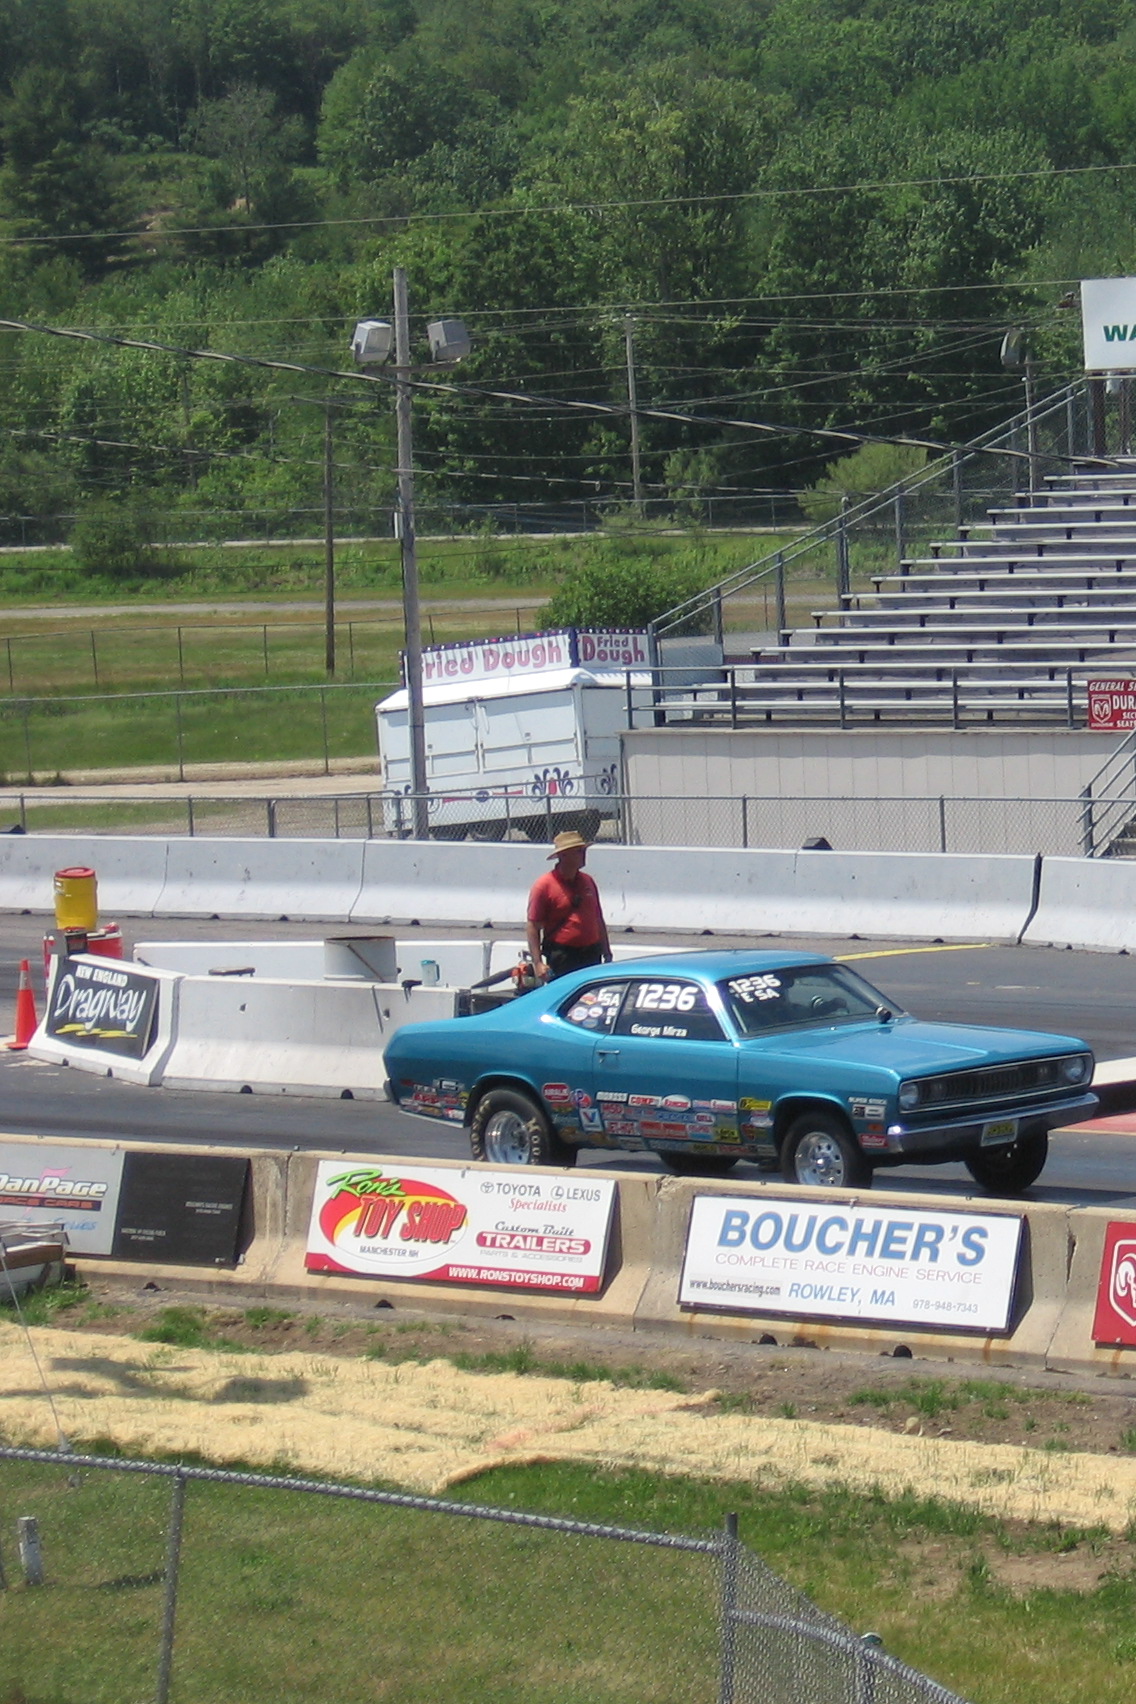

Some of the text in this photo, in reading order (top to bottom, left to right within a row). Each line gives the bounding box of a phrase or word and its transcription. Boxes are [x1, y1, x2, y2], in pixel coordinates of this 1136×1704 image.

[582, 635, 645, 665] Dough
[597, 636, 629, 649] Fried
[421, 641, 562, 679] ried Dough
[1089, 681, 1125, 691] GENERAL
[75, 965, 129, 988] NEW ENGLAND
[728, 974, 782, 994] 1236
[54, 974, 147, 1033] Dragway
[635, 983, 698, 1011] 1236
[740, 988, 780, 1003] E SA
[631, 1023, 688, 1038] George Mirza
[326, 1169, 407, 1199] Ron's
[496, 1182, 601, 1202] TOYOTA LEXUS
[509, 1197, 568, 1213] Specialists
[354, 1195, 468, 1245] TOY SHOP
[495, 1221, 575, 1236] Custom Built
[482, 1232, 586, 1254] TRAILERS
[717, 1209, 989, 1267] BOUCHER'S
[360, 1245, 419, 1258] MANCHESTER NH
[480, 1250, 509, 1258] PARTS
[522, 1252, 583, 1263] ACCESSORIES
[448, 1266, 585, 1288] WWW.RONSTOYSHOP.COM
[715, 1252, 983, 1284] COMPLETE RACE ENGINE SERVICE
[689, 1277, 979, 1314] www.bouchersracing.com ROWLEY, MA 978-948-7343
